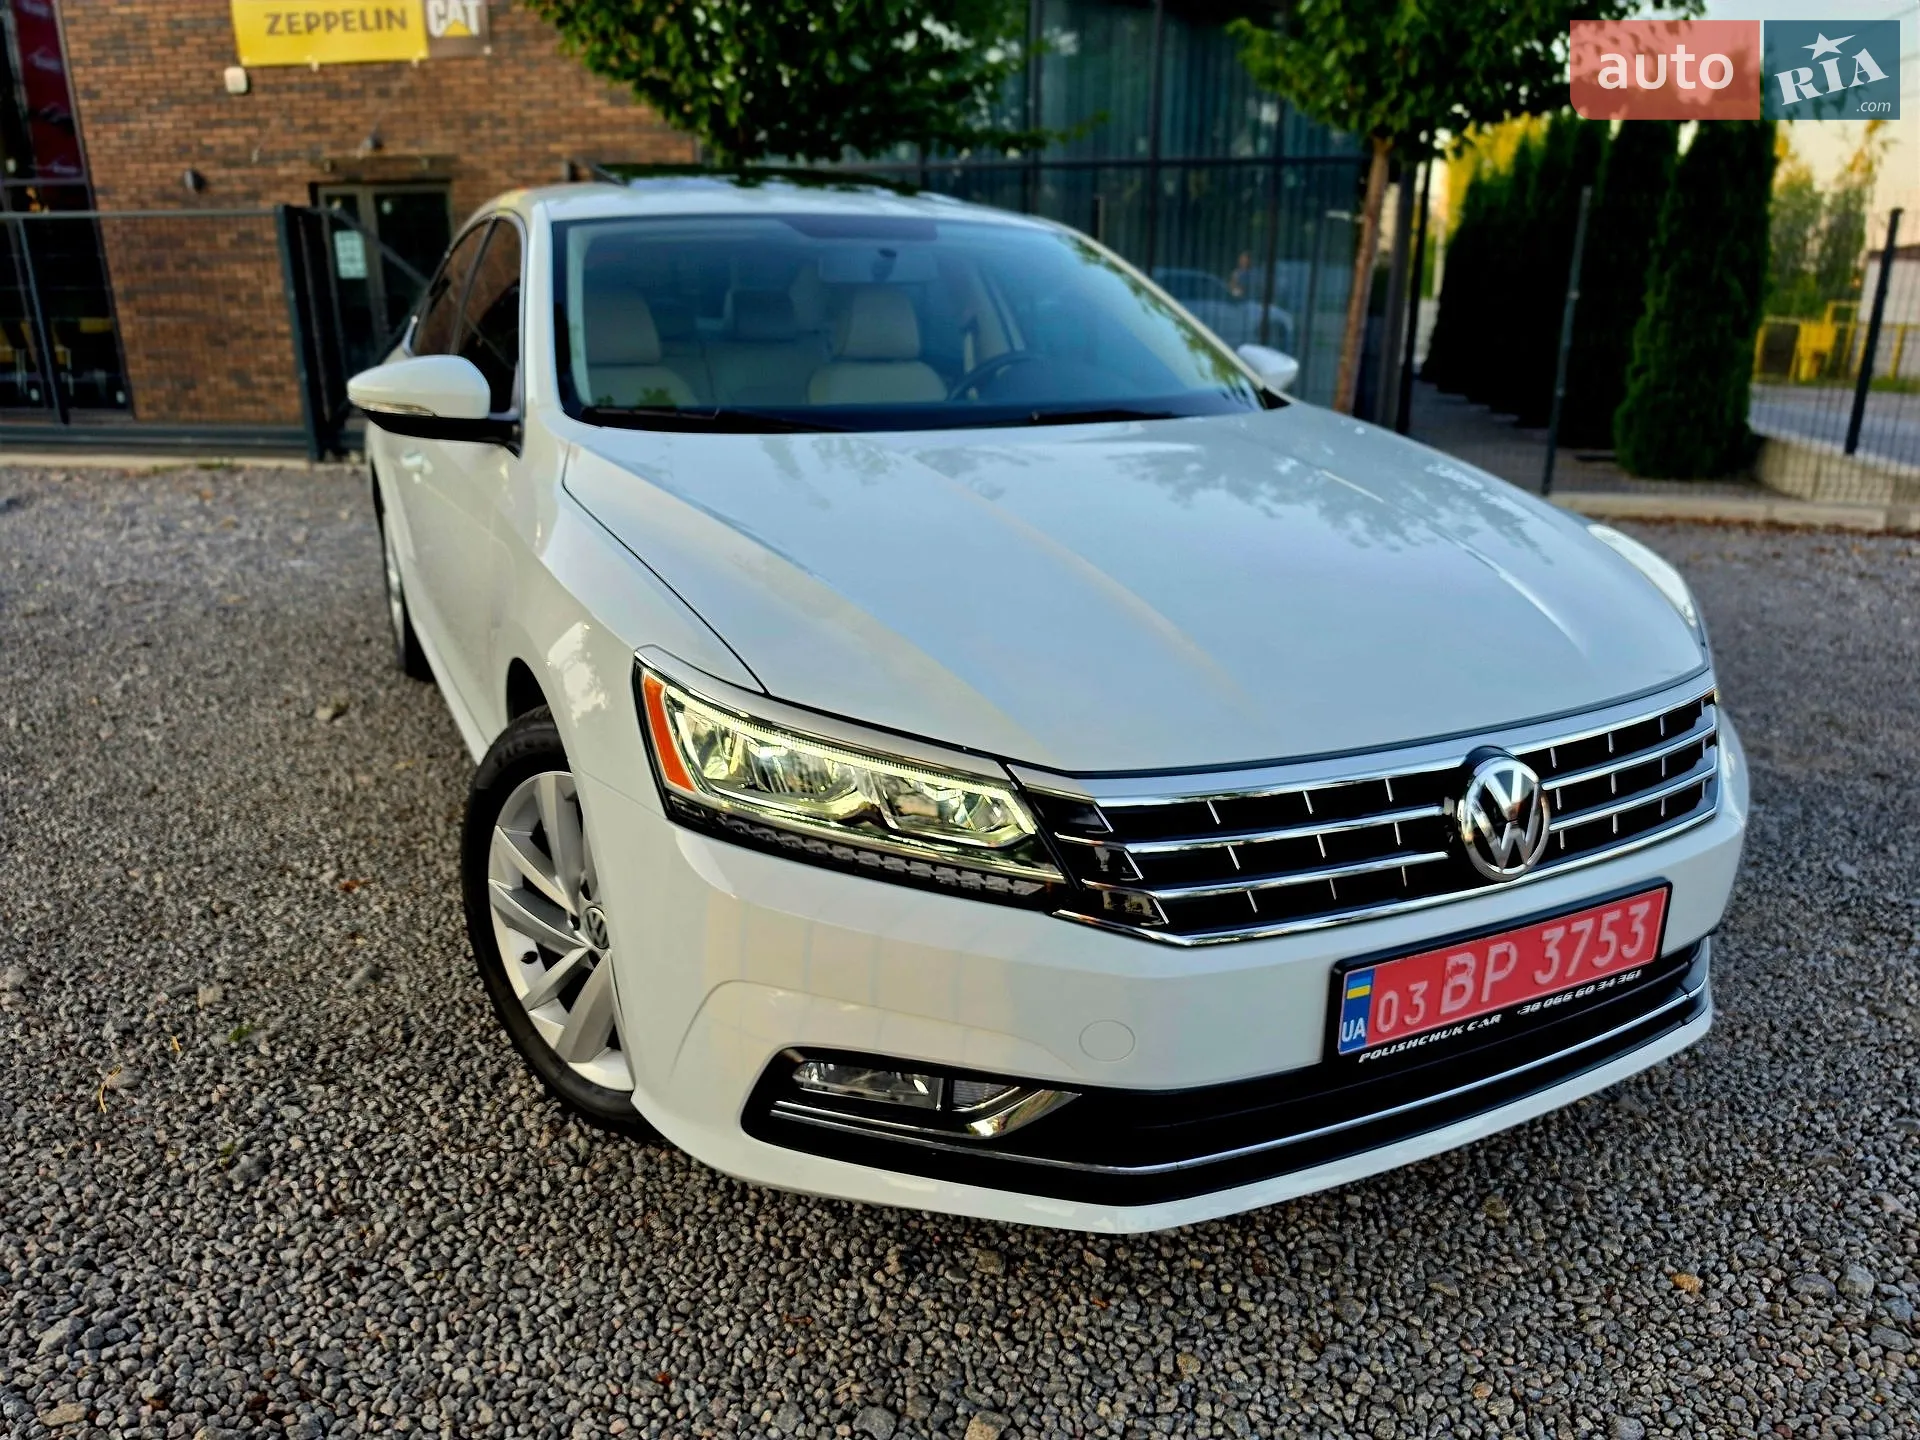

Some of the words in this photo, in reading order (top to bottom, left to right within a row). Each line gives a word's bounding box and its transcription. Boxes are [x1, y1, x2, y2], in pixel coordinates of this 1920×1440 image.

[265, 6, 408, 36] ZEPPELIN
[427, 0, 480, 37] CAT
[1376, 980, 1428, 1033] 03
[1440, 941, 1518, 1015] BP
[1533, 901, 1650, 984] 3753
[1342, 1017, 1366, 1042] UA
[1358, 1025, 1464, 1063] POLISHCHUK
[1467, 1014, 1502, 1032] CAR
